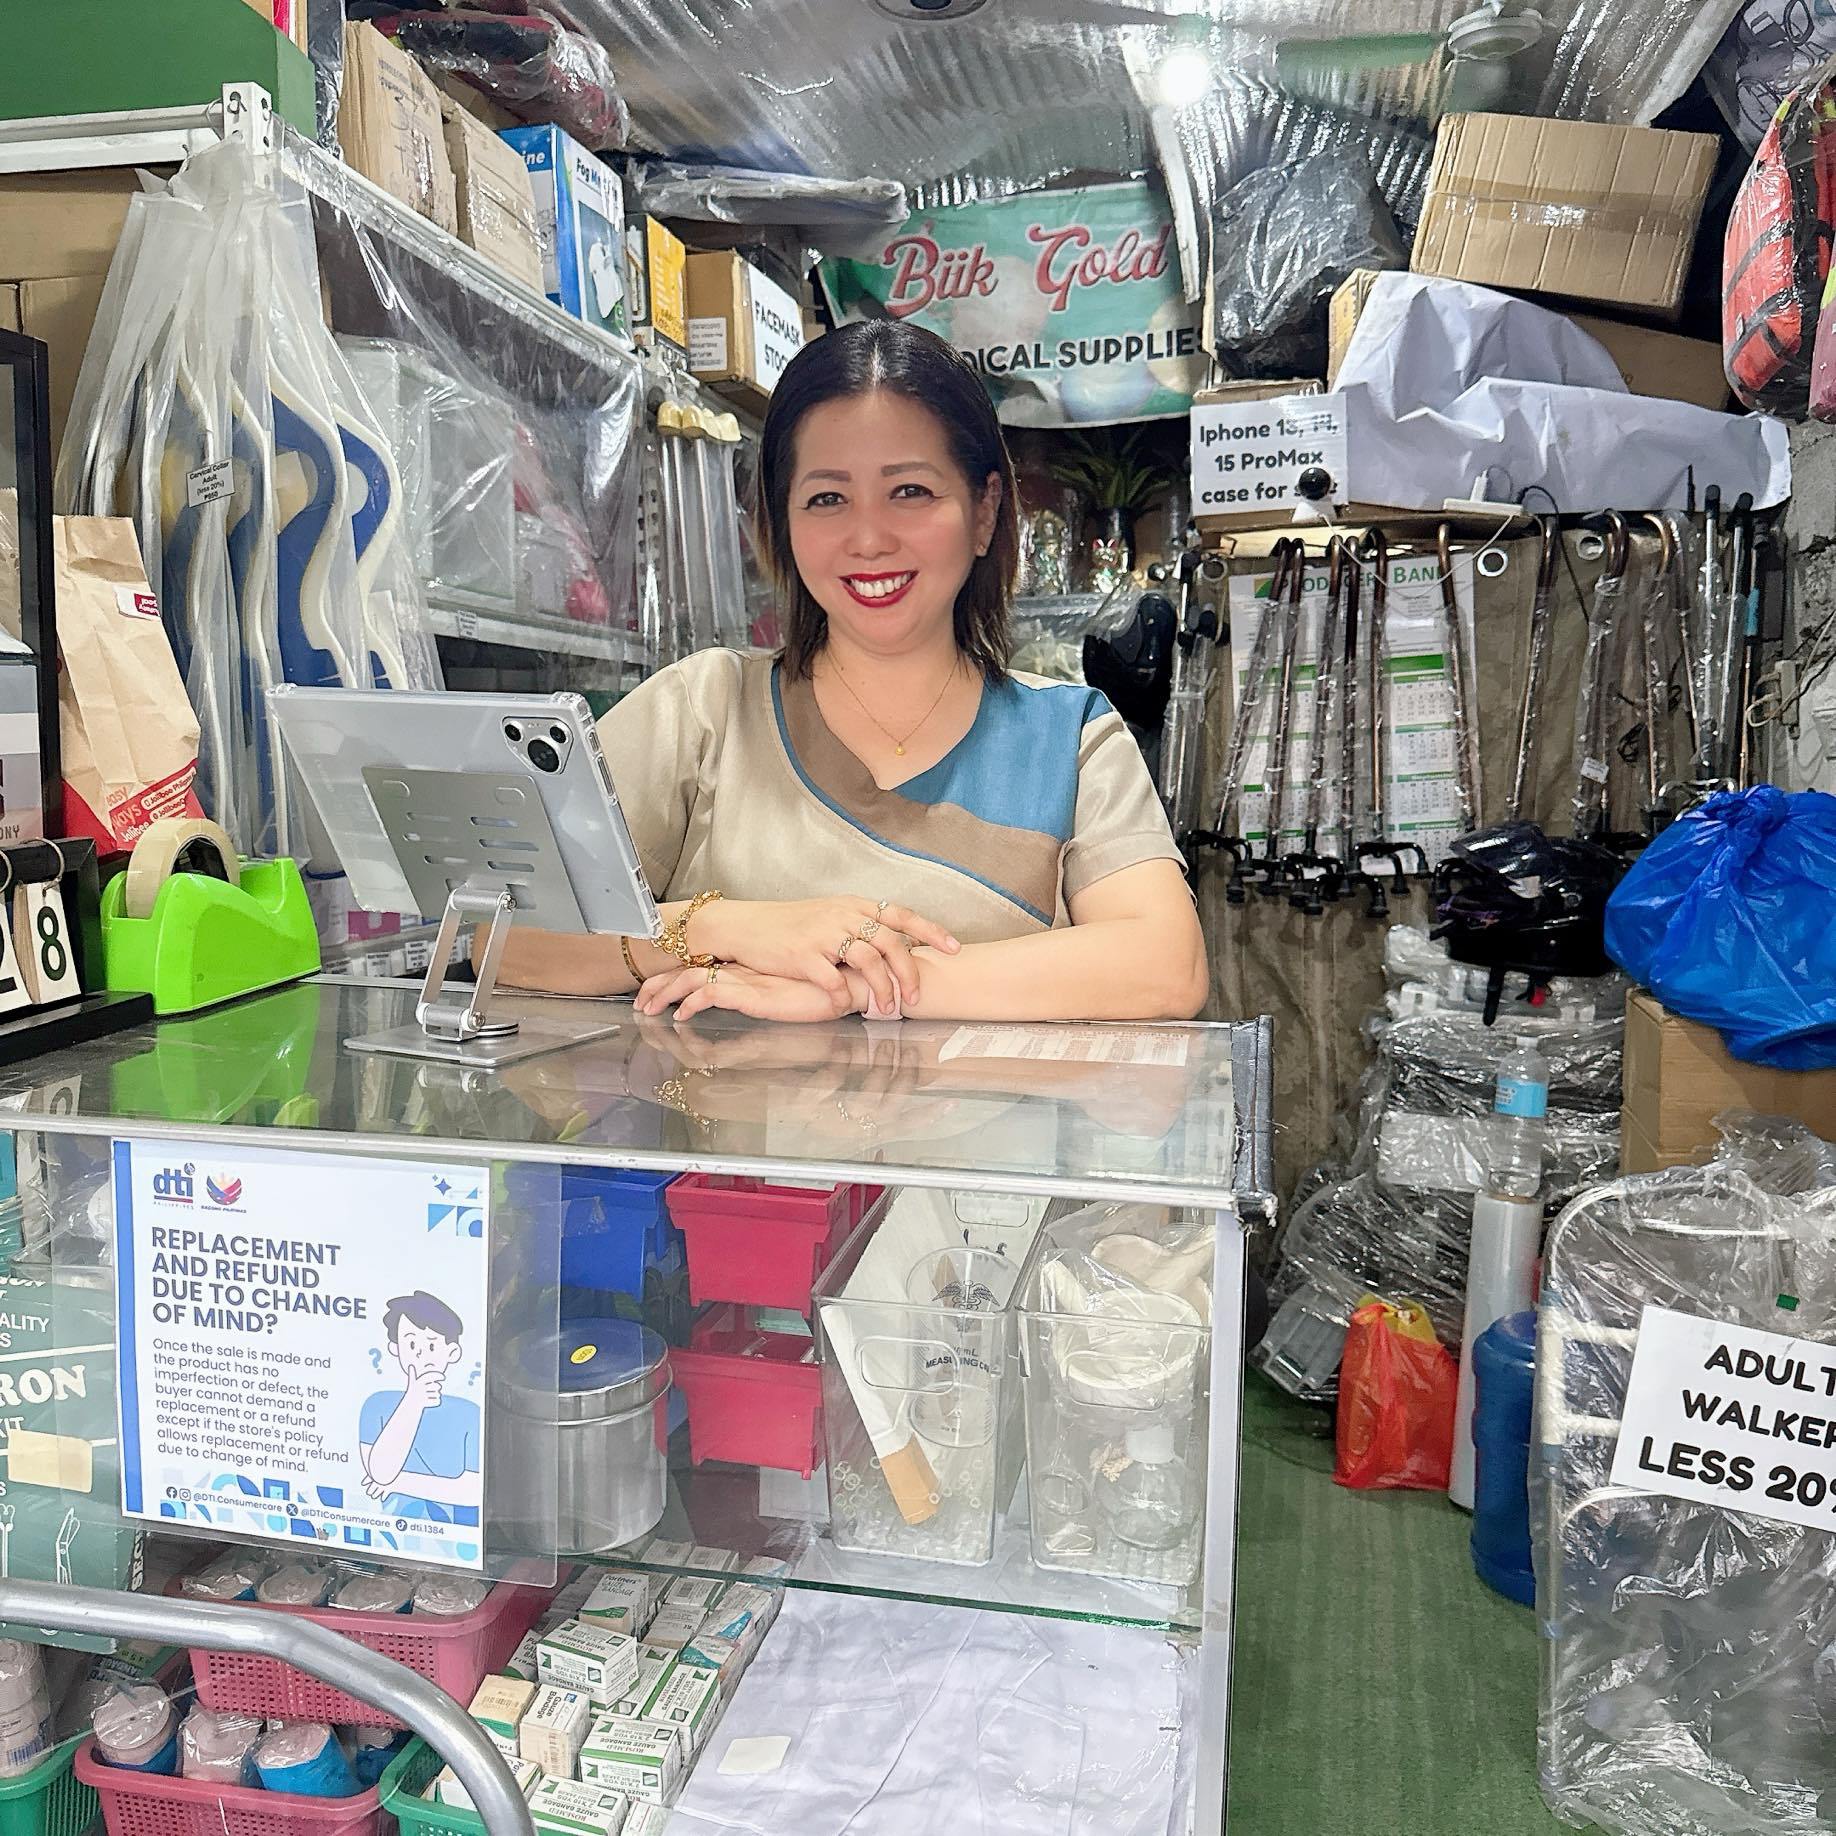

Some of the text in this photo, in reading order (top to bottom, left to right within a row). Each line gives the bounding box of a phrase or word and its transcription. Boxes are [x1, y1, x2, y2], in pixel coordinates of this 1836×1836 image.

[1028, 223, 1173, 312] Gold
[754, 300, 801, 345] FACEMASK
[764, 343, 790, 374] STOC
[1058, 326, 1204, 368] SUPPLIE
[1200, 423, 1271, 447] Iphone
[1214, 448, 1323, 473] 15 ProMax
[1201, 487, 1250, 505] case
[1254, 481, 1288, 500] for
[1392, 564, 1443, 585] BAN
[120, 820, 151, 843] Jollibee
[37, 906, 67, 982] 8
[153, 1163, 195, 1197] dti
[152, 1227, 341, 1266] REPLACEMENT
[152, 1252, 320, 1289] AND REFUND
[152, 1277, 367, 1319] DUE TO CHANGE
[152, 1302, 278, 1335] OF MIND?
[0, 1333, 12, 1349] S
[153, 1338, 331, 1369] Once the sale is made and
[154, 1353, 280, 1378] the product has no
[1703, 1344, 1836, 1397] ADULT
[154, 1368, 329, 1400] imperfection or defect, the
[155, 1383, 316, 1413] buyer cannot demand a
[156, 1399, 316, 1428] replacement or a refund
[156, 1414, 324, 1448] except if the store's policy
[157, 1428, 349, 1463] allows replacement or refund
[157, 1442, 309, 1473] due to change of mind.
[1638, 1436, 1836, 1514] LESS 20
[301, 1507, 390, 1529] @DTIConsumercare
[601, 1587, 635, 1597] BANDAGE
[536, 1690, 558, 1719] Bandage
[546, 1696, 561, 1717] Gauze
[548, 1807, 587, 1822] ROSEMED
